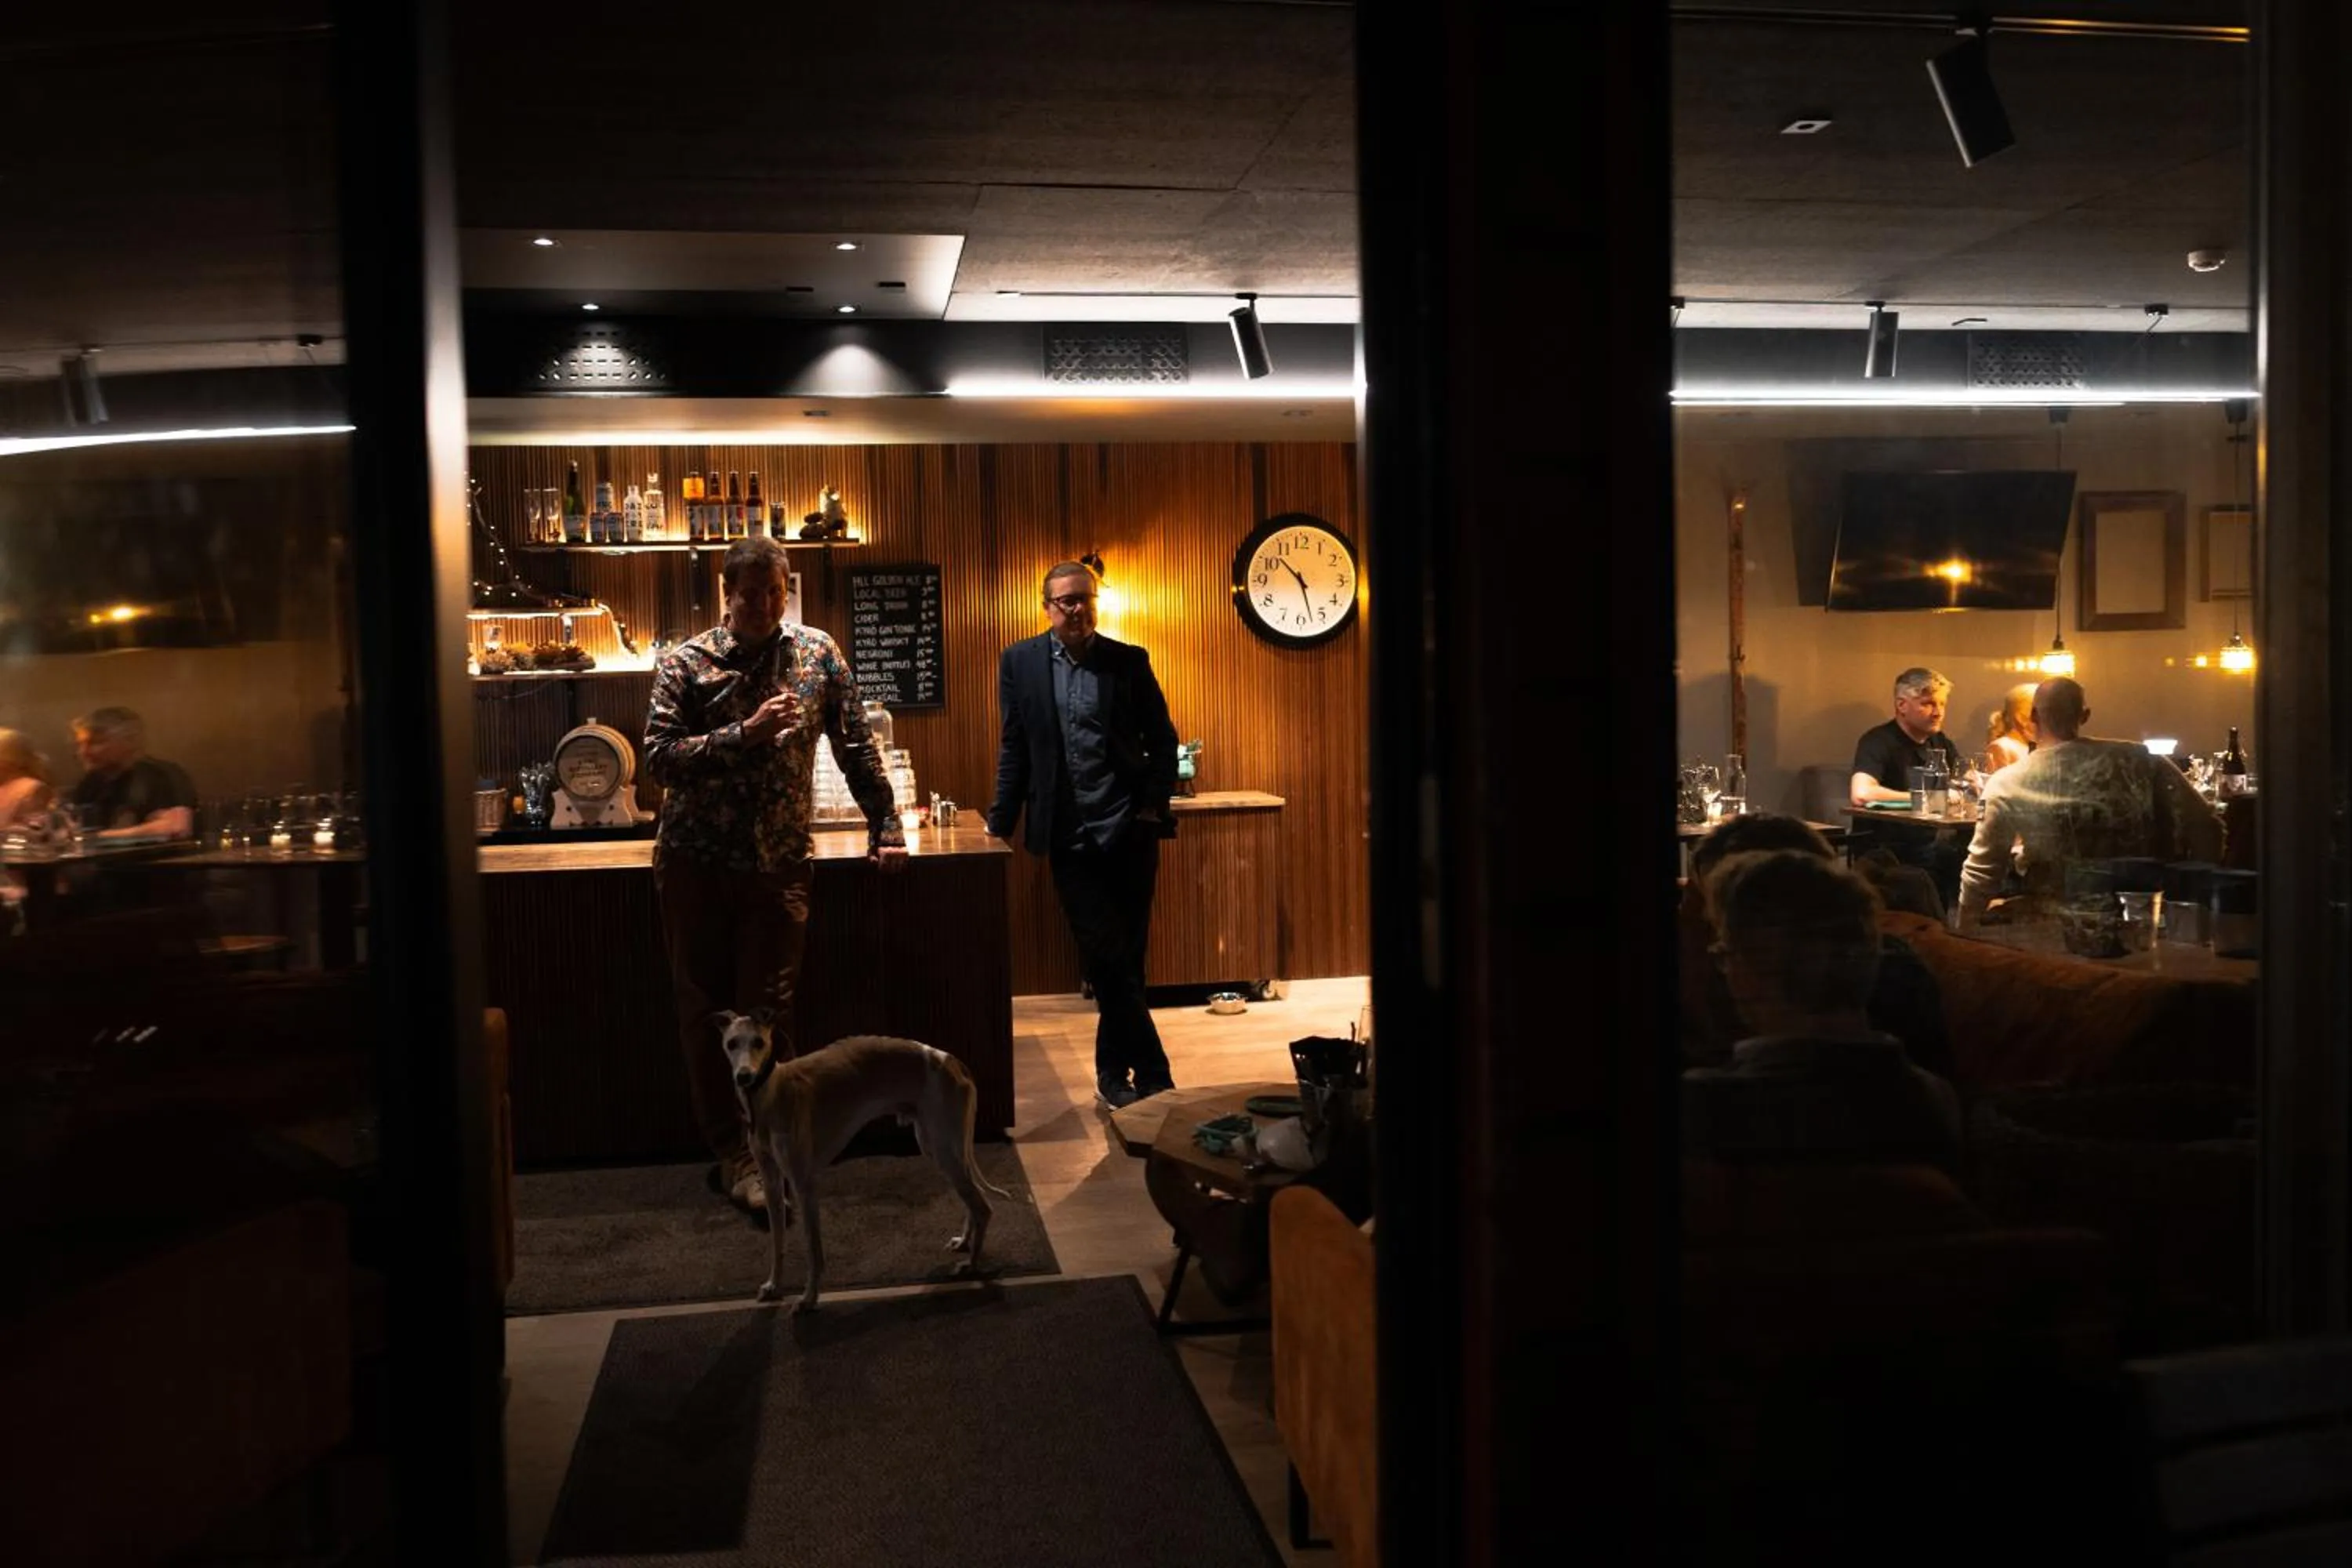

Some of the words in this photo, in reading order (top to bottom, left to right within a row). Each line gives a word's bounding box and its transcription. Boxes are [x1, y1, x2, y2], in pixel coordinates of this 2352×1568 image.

[1294, 535, 1309, 550] 12
[1317, 542, 1322, 555] 1
[1278, 543, 1290, 556] 11
[1265, 557, 1279, 571] 10
[1329, 554, 1338, 567] 2
[1257, 573, 1268, 587] 9
[1335, 573, 1345, 588] 3
[854, 601, 879, 611] LONG
[1263, 593, 1274, 608] 8
[1330, 593, 1338, 606] 4
[854, 612, 879, 624] CIDER
[1279, 608, 1287, 621] 7
[1296, 614, 1307, 626] 6
[1317, 607, 1326, 620] 5
[855, 649, 893, 659] NEGRONI
[856, 661, 878, 671] WINE
[856, 672, 895, 682] BUBBLES
[858, 683, 901, 694] MOCKTAIL
